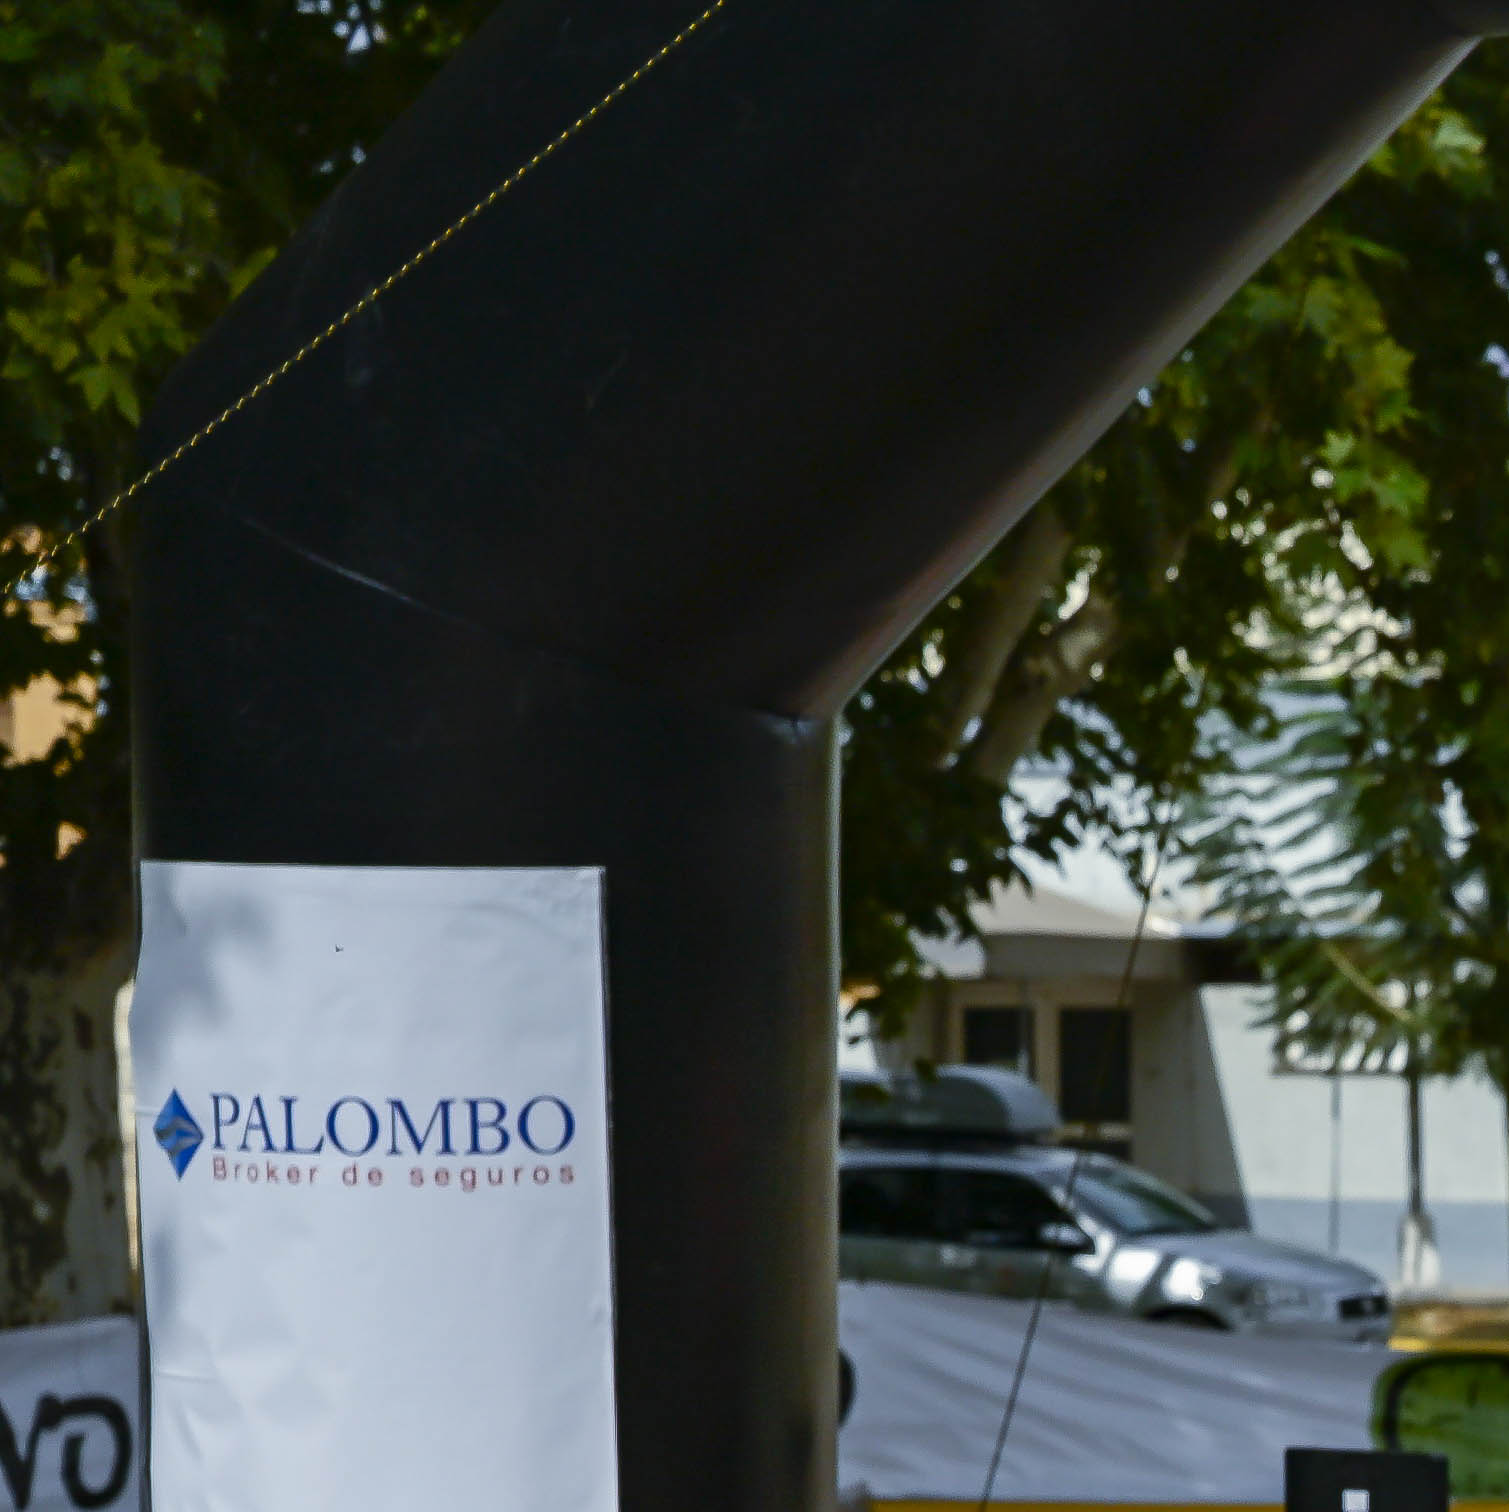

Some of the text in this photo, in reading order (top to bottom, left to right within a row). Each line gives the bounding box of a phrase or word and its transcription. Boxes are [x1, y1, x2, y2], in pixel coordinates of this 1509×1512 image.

[210, 1092, 576, 1157] PALOMBO
[212, 1156, 576, 1193] Broker de seguros
